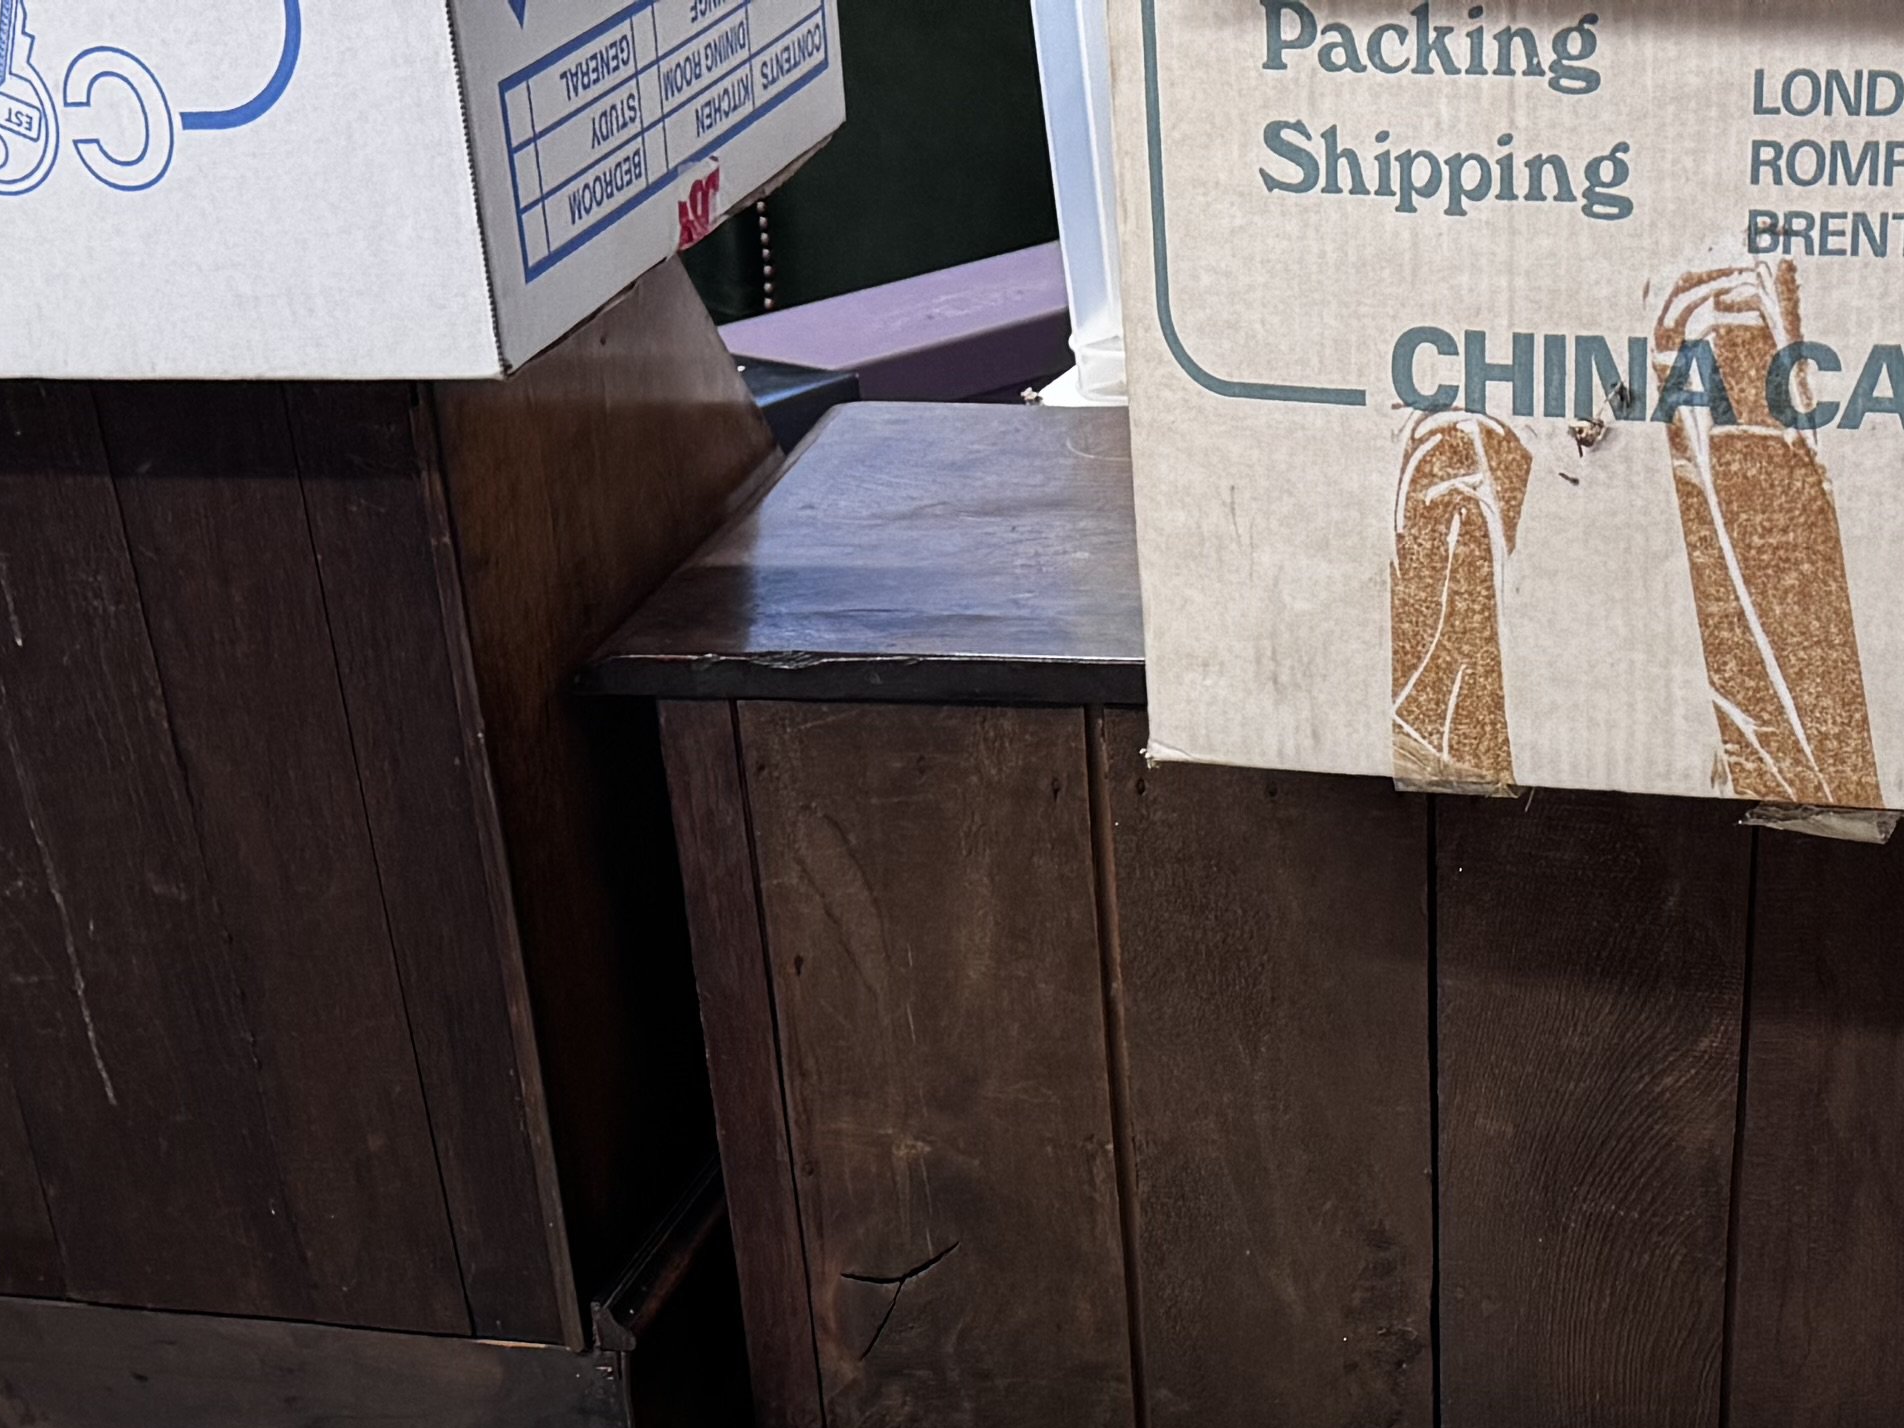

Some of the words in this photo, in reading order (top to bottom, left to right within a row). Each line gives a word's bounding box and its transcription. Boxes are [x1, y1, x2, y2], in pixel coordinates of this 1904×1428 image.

[559, 34, 631, 101] GENERAL
[662, 49, 703, 101] ROOM
[704, 20, 747, 72] DINING
[760, 22, 823, 91] CONTENTS
[1259, 0, 1601, 95] Packing
[4, 106, 34, 132] EST
[590, 92, 639, 150] STUDY
[695, 72, 752, 138] KITCHEN
[567, 147, 644, 226] BEDROOM
[1258, 119, 1635, 221] Shipping
[1388, 324, 1739, 425] CHINA
